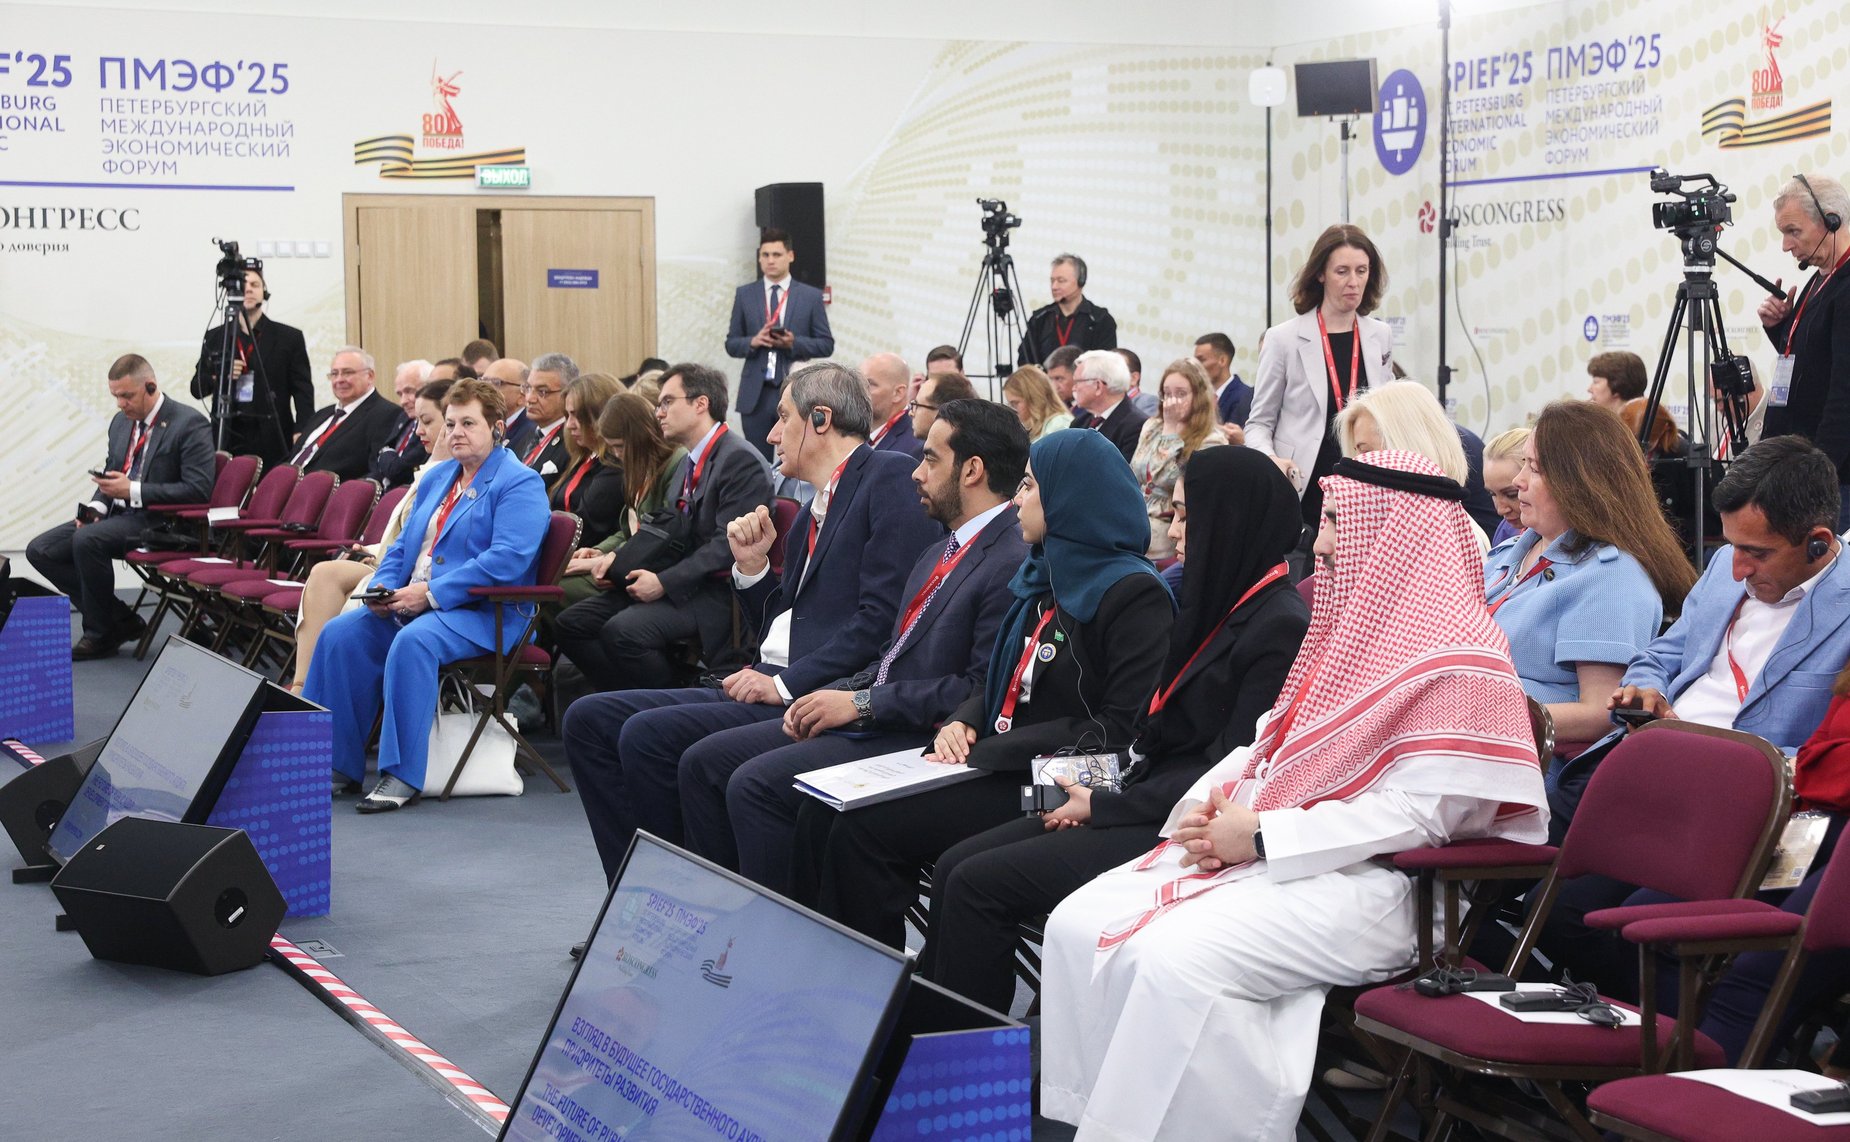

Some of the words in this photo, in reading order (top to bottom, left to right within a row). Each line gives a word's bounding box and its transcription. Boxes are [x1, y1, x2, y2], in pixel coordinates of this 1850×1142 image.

[1447, 51, 1533, 92] PIEF'25
[1752, 69, 1769, 93] 80
[1546, 75, 1646, 105] ПЕТЕРБУРГСКИЙ
[100, 98, 267, 117] ПЕТЕРБУРГСКИЙ
[1456, 93, 1524, 114] PETERSBURG
[1546, 96, 1662, 125] МЕЖДУНАРОДНЫЙ
[101, 118, 294, 139] МЕЖДУНАРОДНЫЙ
[422, 113, 445, 134] 80
[1545, 117, 1659, 145] ЭКОНОМИЧЕСКИЙ
[101, 138, 290, 158] ЭКОНОМИЧЕСКИЙ
[422, 137, 464, 150] ПОБЕДА!
[1446, 135, 1497, 154] CONOMIC
[1445, 157, 1477, 174] ORUM
[1545, 147, 1589, 165] ФОРУМ
[102, 159, 178, 175] ФОРУМ
[1449, 198, 1566, 227] OSCONGRESS
[8, 242, 70, 256] доверия
[561, 1038, 616, 1086] ПРИОРИТЕТЫ
[613, 1074, 659, 1118] РАЗВИТИЯ
[571, 1016, 601, 1052] ВЗГЛЯД
[600, 1036, 611, 1052] В
[608, 1040, 650, 1080] БУДУЩЕЕ
[648, 1066, 739, 1140] ГОСУДАРСТВЕННОГО
[542, 1082, 560, 1107] THE
[556, 1094, 590, 1129] FUTURE
[586, 1116, 601, 1137] OF
